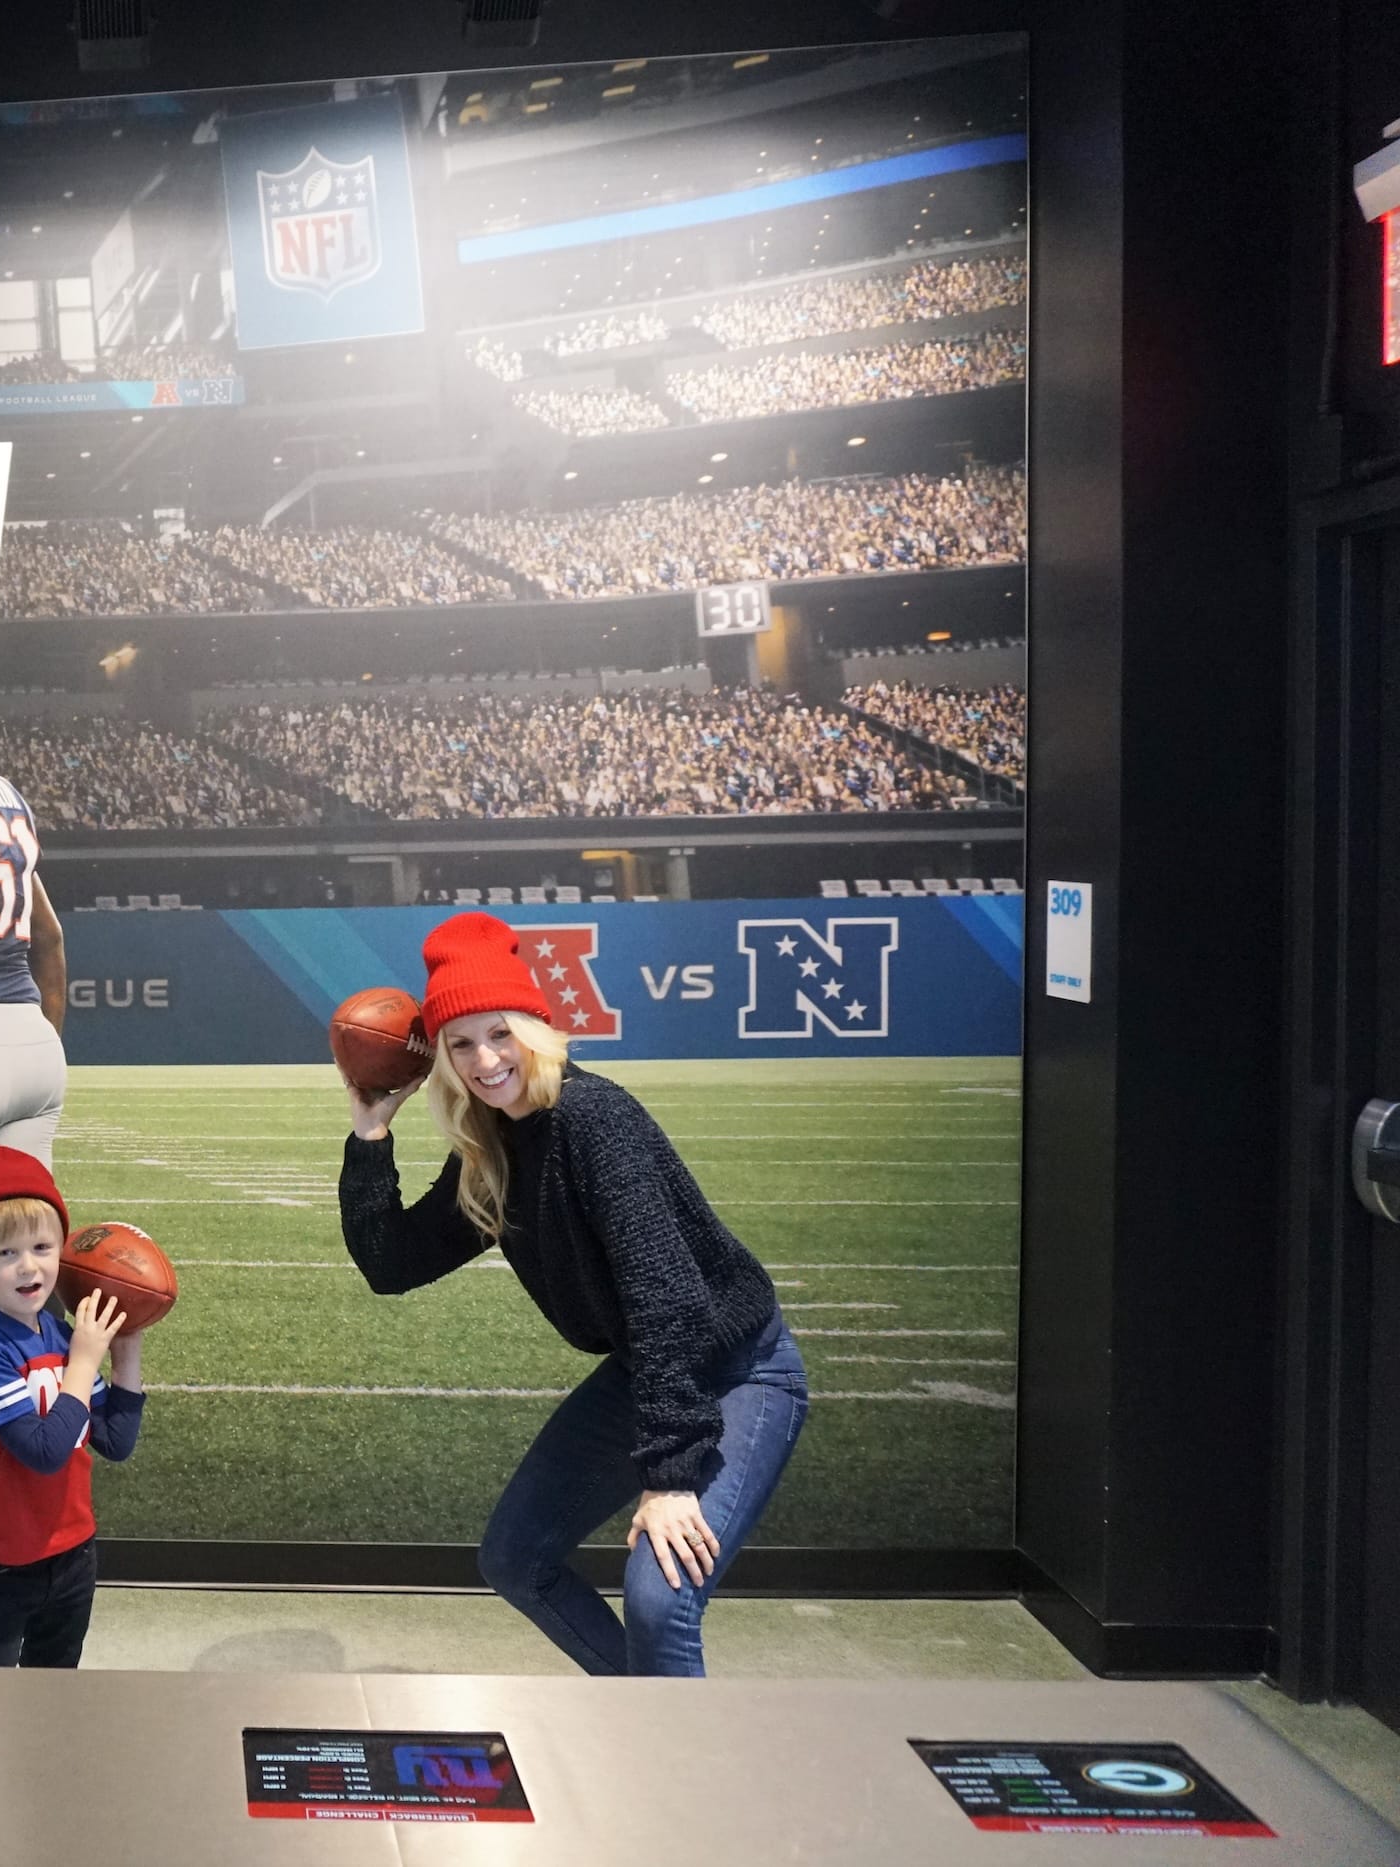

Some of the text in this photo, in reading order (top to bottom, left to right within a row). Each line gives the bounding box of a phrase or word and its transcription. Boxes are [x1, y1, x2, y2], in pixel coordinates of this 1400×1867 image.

[275, 213, 369, 279] NFL
[708, 586, 761, 631] 30
[1050, 887, 1082, 917] 309
[640, 963, 716, 1001] VS
[737, 916, 900, 1040] N
[316, 1810, 470, 1822] QUARTERBACK CHALLENGE
